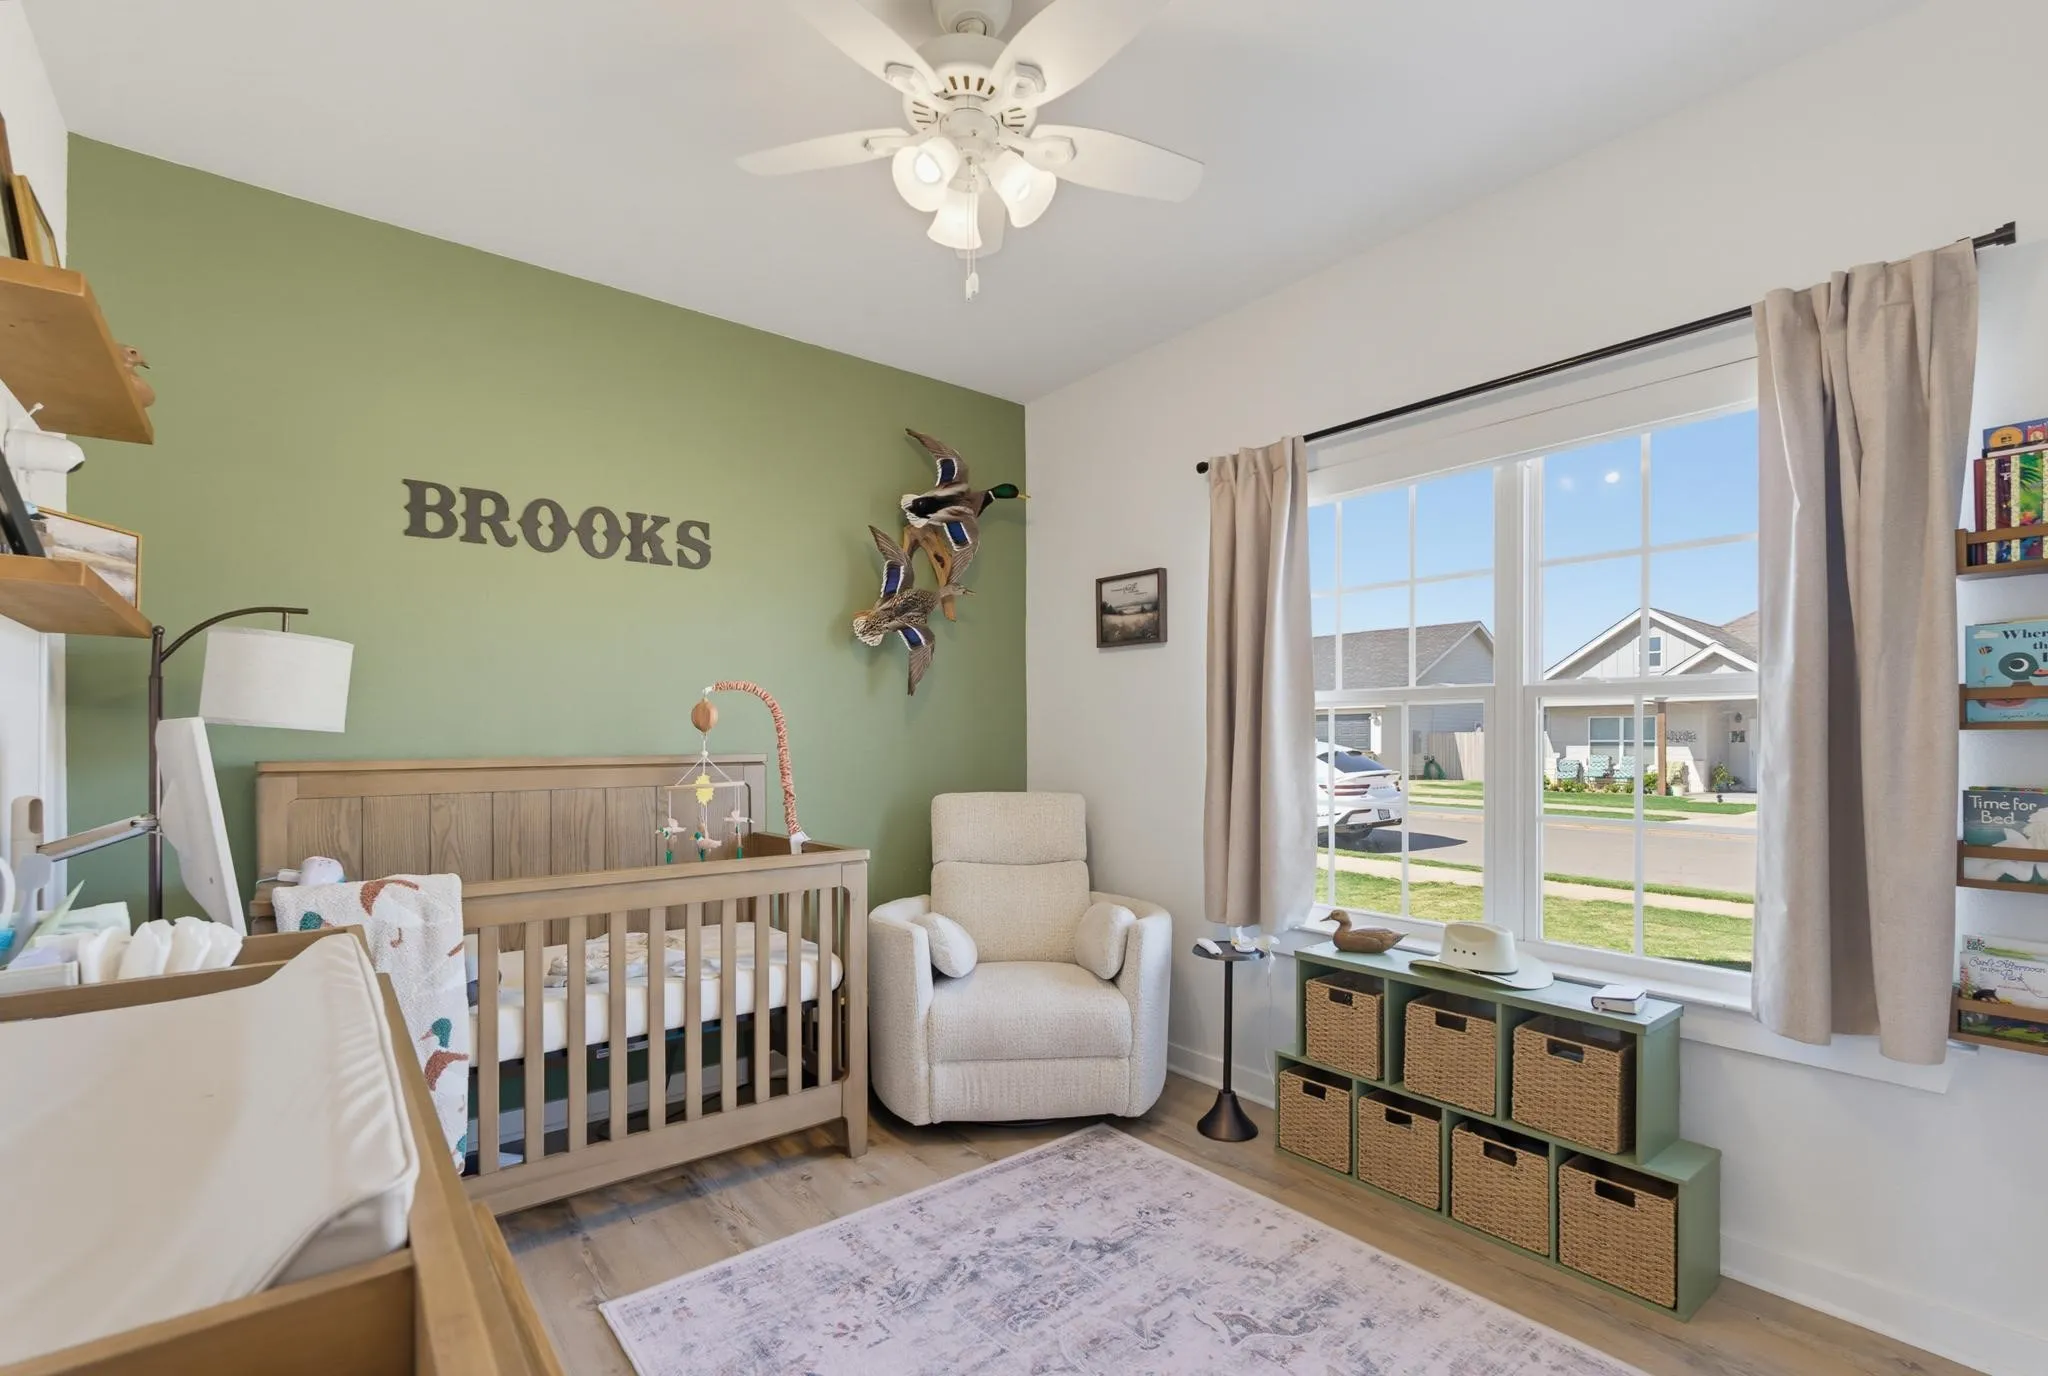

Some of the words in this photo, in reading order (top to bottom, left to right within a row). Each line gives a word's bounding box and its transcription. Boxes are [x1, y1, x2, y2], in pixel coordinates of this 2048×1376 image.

[402, 478, 711, 569] BROOKS
[1968, 795, 2010, 810] Time
[2013, 797, 2037, 811] for
[1981, 810, 2015, 825] Bed
